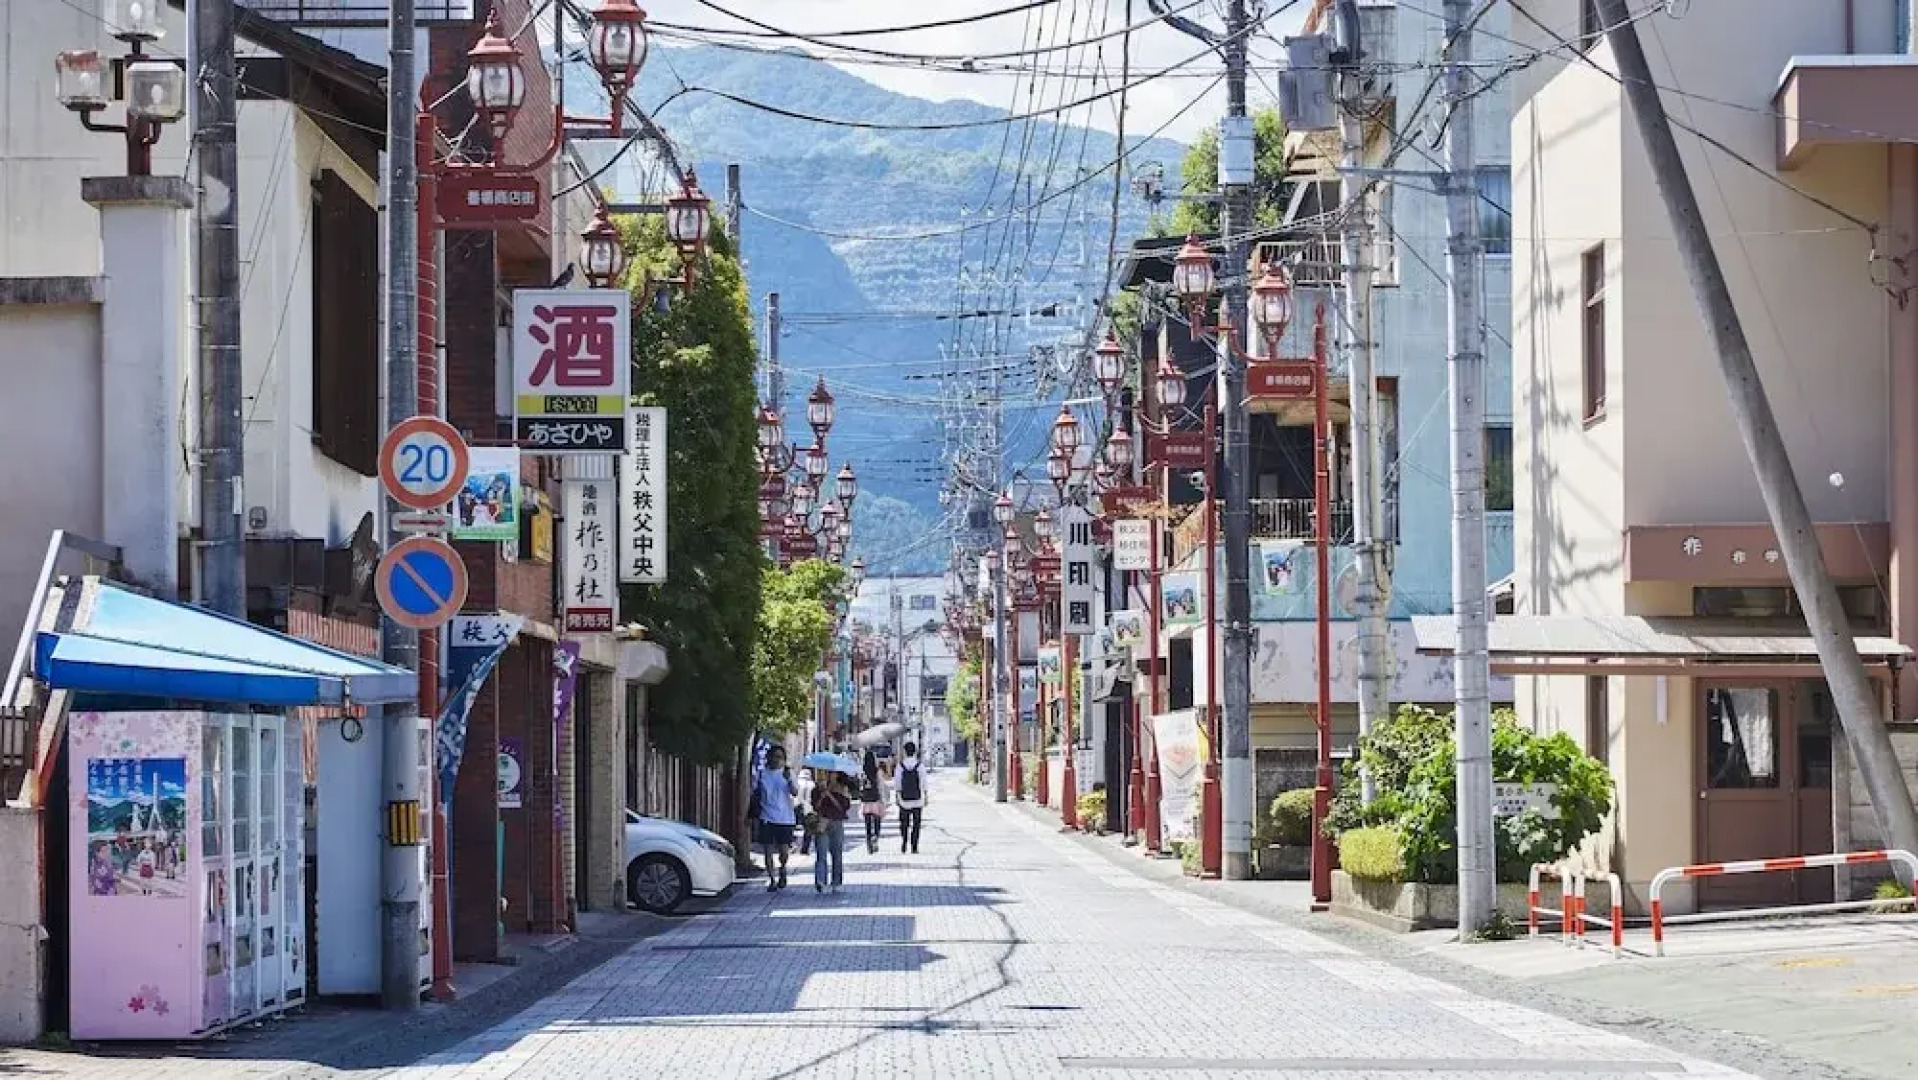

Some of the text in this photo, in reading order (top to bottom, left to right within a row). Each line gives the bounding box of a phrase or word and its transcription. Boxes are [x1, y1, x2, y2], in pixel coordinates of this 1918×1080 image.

[528, 305, 617, 387] 酒
[528, 422, 613, 445] あさひや
[400, 445, 448, 483] 20
[633, 412, 653, 577] 税理士法人秩父中央
[1069, 522, 1089, 625] 川印刷
[462, 620, 510, 642] 秩父
